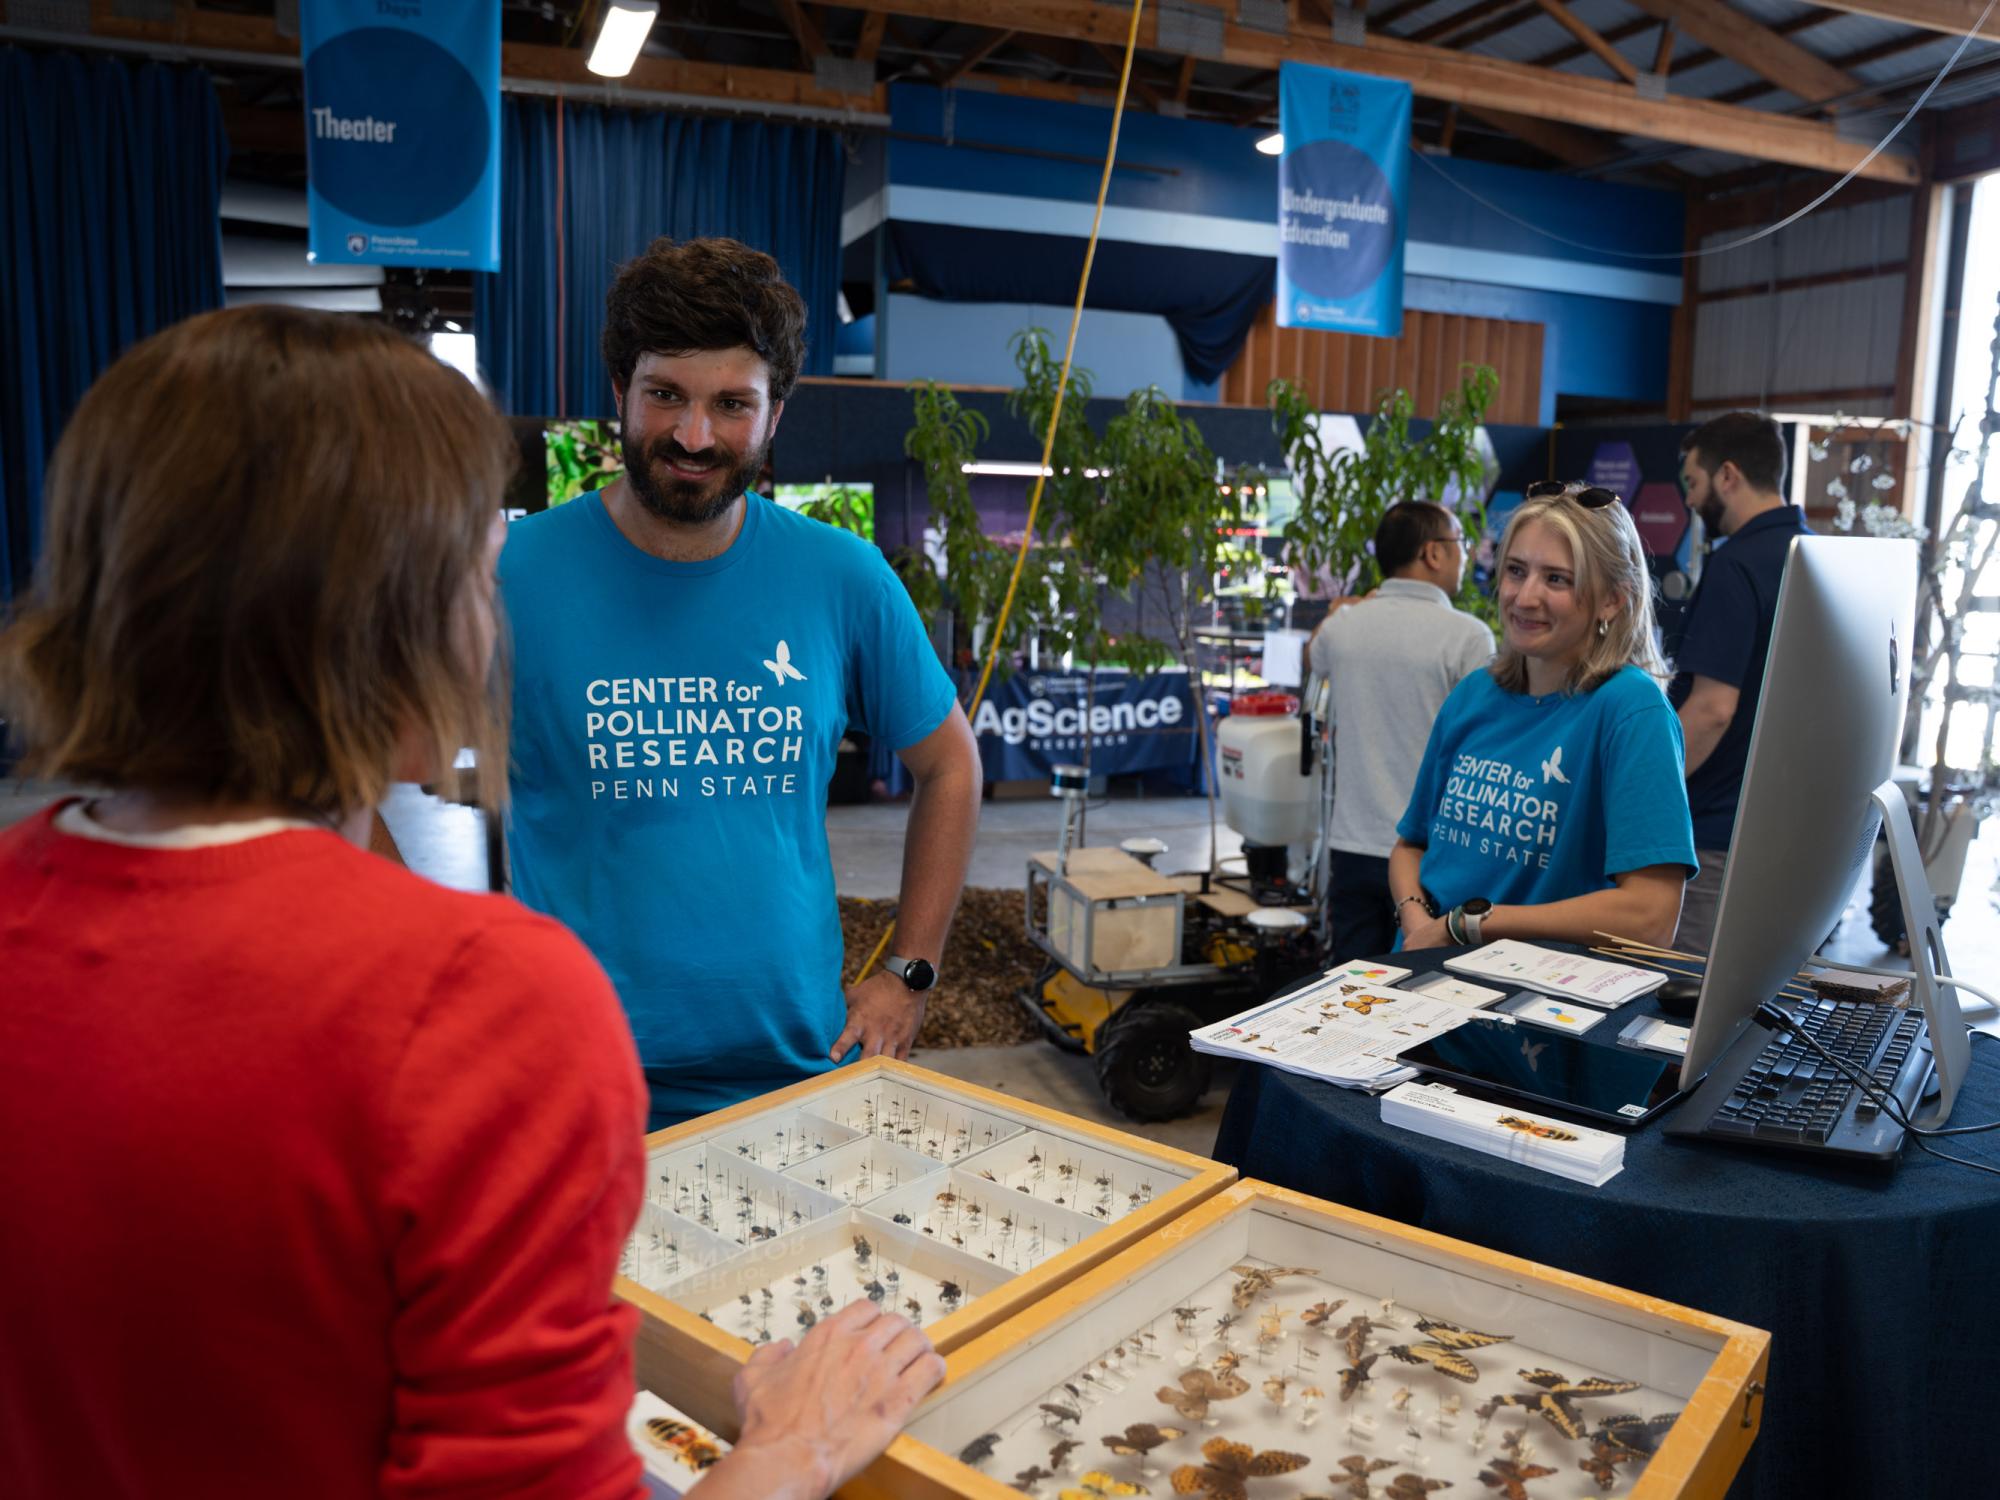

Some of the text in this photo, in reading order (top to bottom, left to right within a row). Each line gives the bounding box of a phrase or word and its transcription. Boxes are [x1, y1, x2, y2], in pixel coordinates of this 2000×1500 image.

[312, 106, 397, 143] Theater
[1282, 187, 1389, 225] Undergraduate
[1281, 216, 1350, 249] Education
[586, 677, 763, 706] CENTER for
[586, 706, 803, 738] POLLINATOR
[973, 696, 1183, 745] AgScience
[588, 736, 803, 769] RESEARCH
[591, 774, 796, 800] PENN STATE
[1512, 770, 1535, 791] for
[1446, 776, 1559, 822] OLLINATOR
[1432, 822, 1551, 869] PENN STATE
